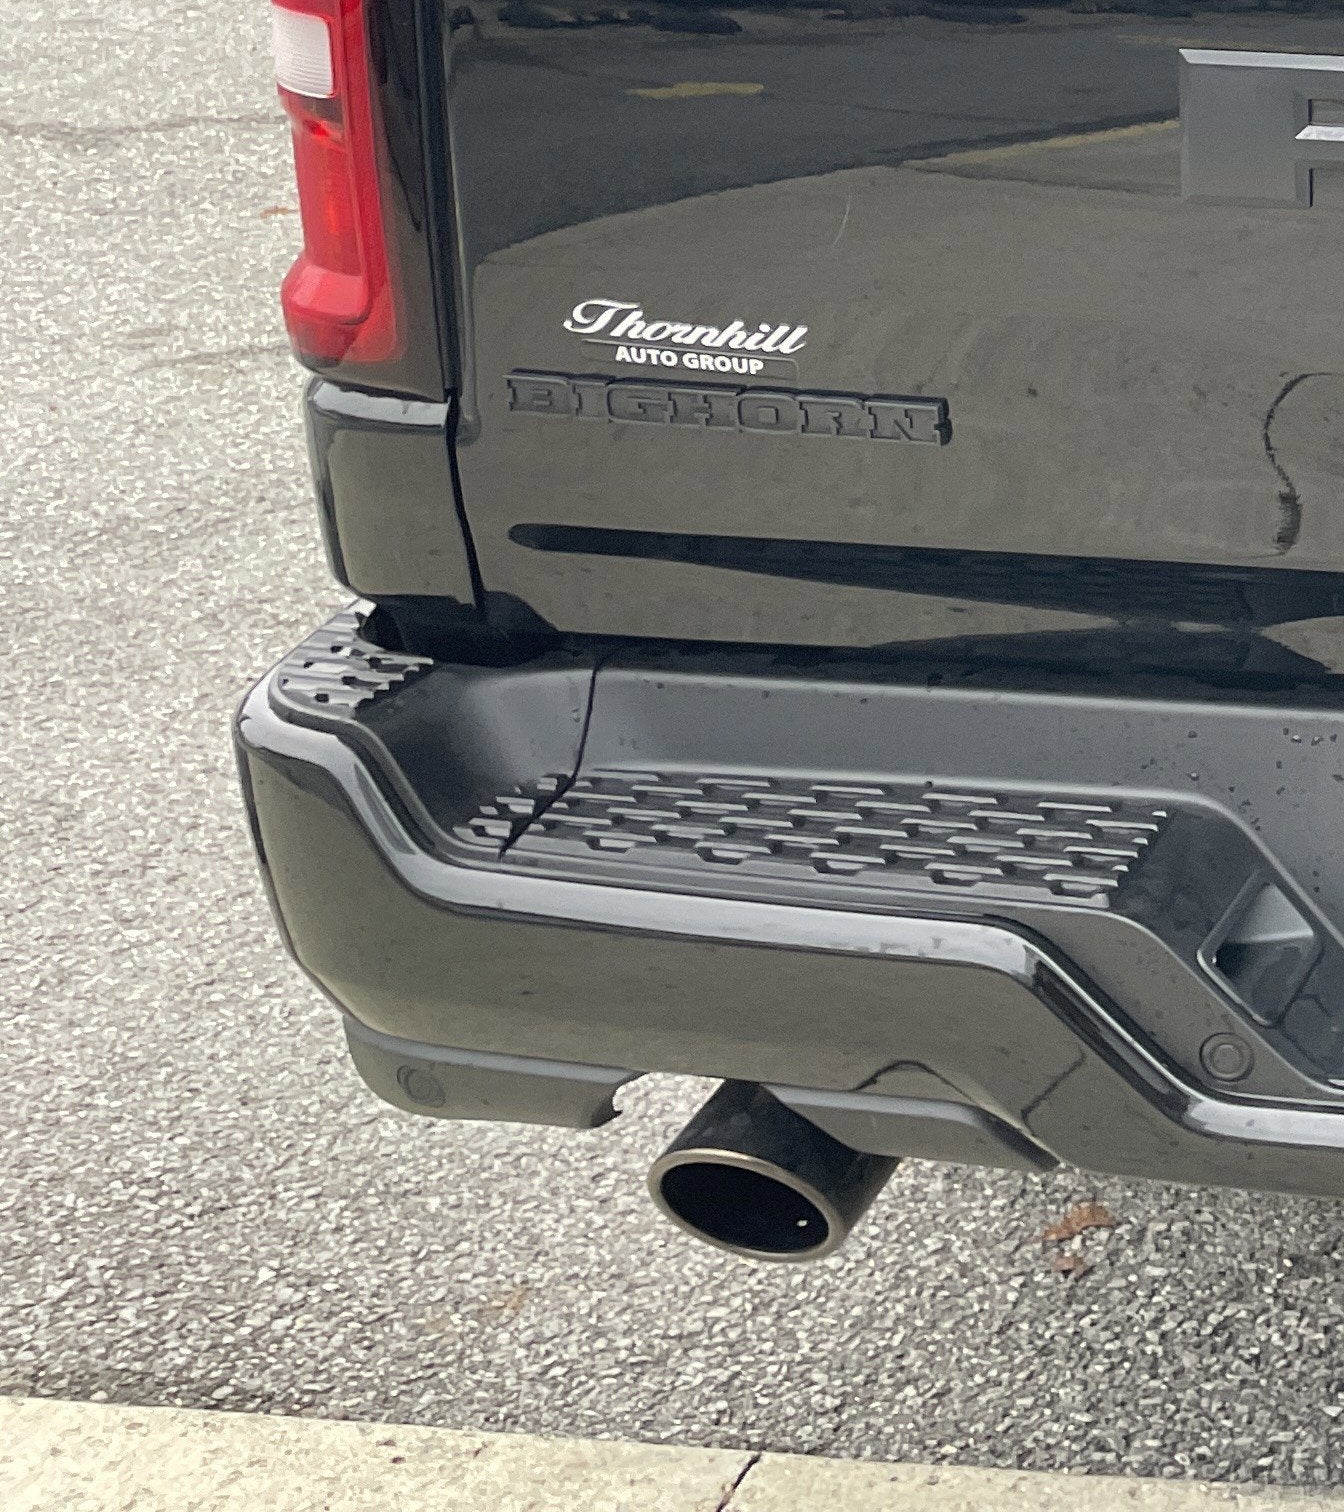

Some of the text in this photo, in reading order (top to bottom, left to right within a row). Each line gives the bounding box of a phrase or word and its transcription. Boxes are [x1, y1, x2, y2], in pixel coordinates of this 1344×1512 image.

[562, 298, 809, 356] Thornhill
[615, 345, 764, 376] AUTO GROUP
